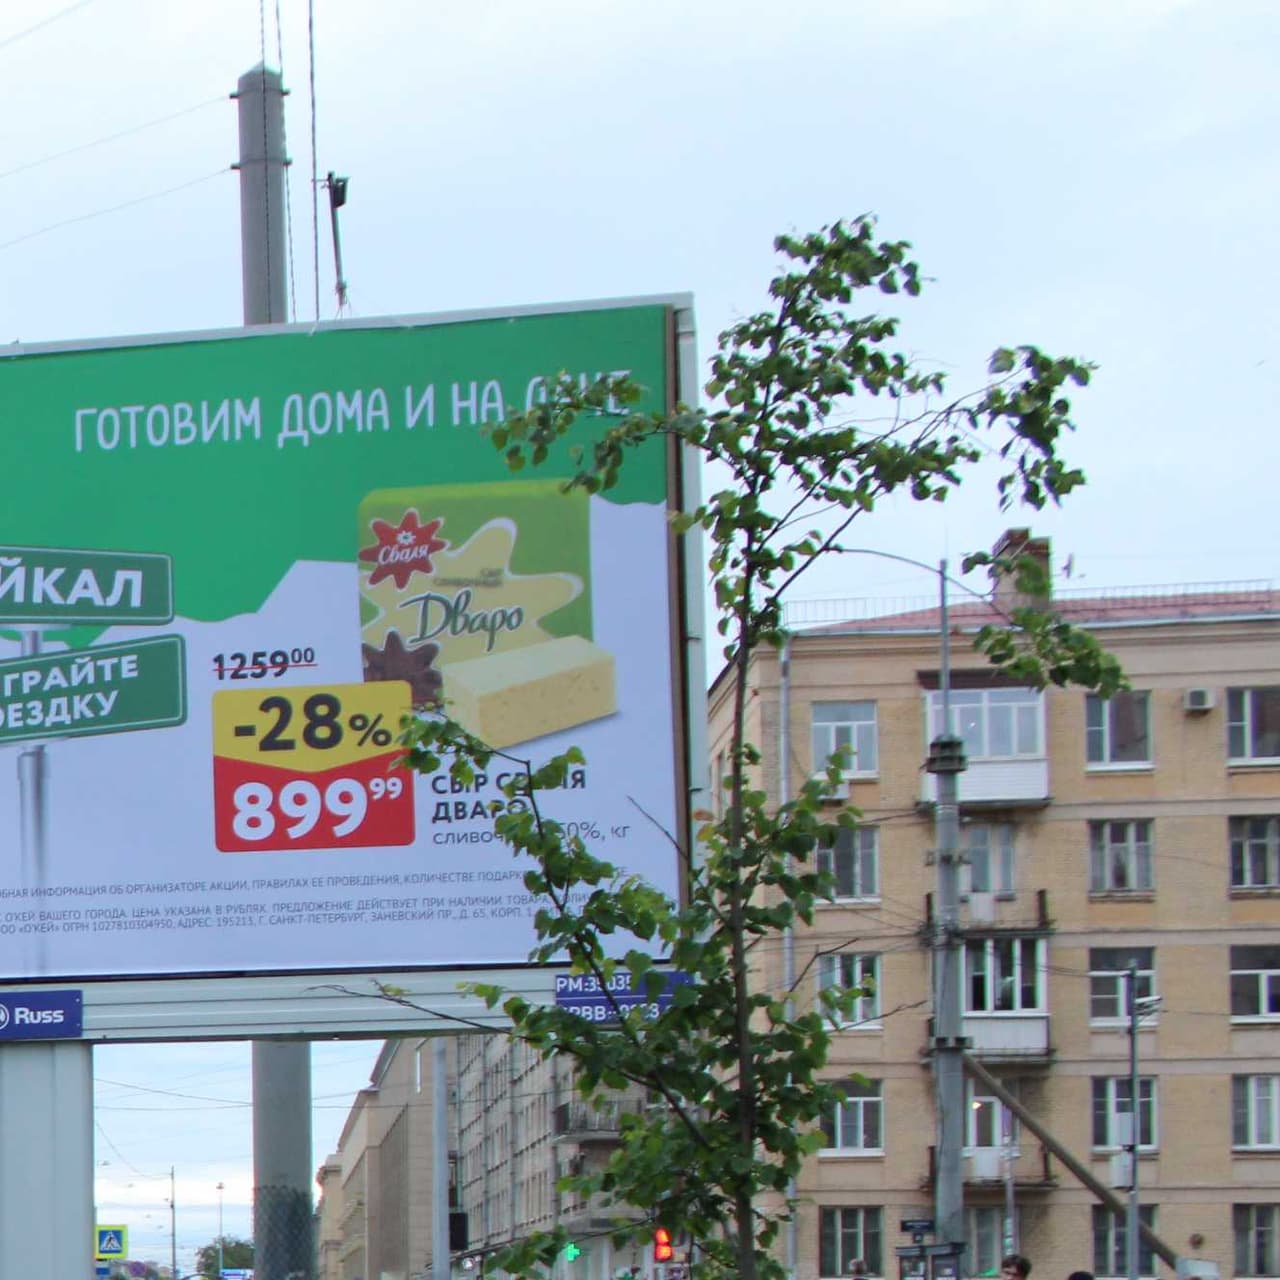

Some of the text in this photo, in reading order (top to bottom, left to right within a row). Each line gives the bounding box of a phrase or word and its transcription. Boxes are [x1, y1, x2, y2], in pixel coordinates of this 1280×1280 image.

[74, 397, 262, 452] ГОТОВИМ
[278, 388, 390, 449] ДОМА
[406, 383, 437, 426] И
[452, 379, 506, 426] НА
[378, 544, 430, 565] Сваля
[398, 588, 524, 653] Дваро
[233, 693, 392, 752] -28%
[432, 774, 488, 794] СЫР
[611, 826, 631, 838] кг
[31, 885, 106, 898] ИНФОРМАЦИЯ
[109, 884, 123, 895] ОБ
[126, 881, 208, 895] ОРГАНИЗАТОРЕ
[252, 878, 309, 889] ПРАВИЛАХ
[311, 877, 323, 888] ЕЕ
[404, 872, 474, 884] КОЛИЧЕСТВЕ
[39, 909, 81, 921] ВАШЕГО
[132, 906, 160, 918] ЦЕНА
[165, 905, 211, 917] УКАЗАНА
[272, 900, 353, 912] ПРЕДЛОЖЕНИЕ
[357, 898, 417, 911] ДЕЙСТВУЕТ
[422, 896, 444, 907] ПРИ
[449, 895, 502, 907] НАЛИЧИИ
[371, 909, 434, 921] ЗАНЕВСКИЙ
[14, 1007, 65, 1025] Russ
